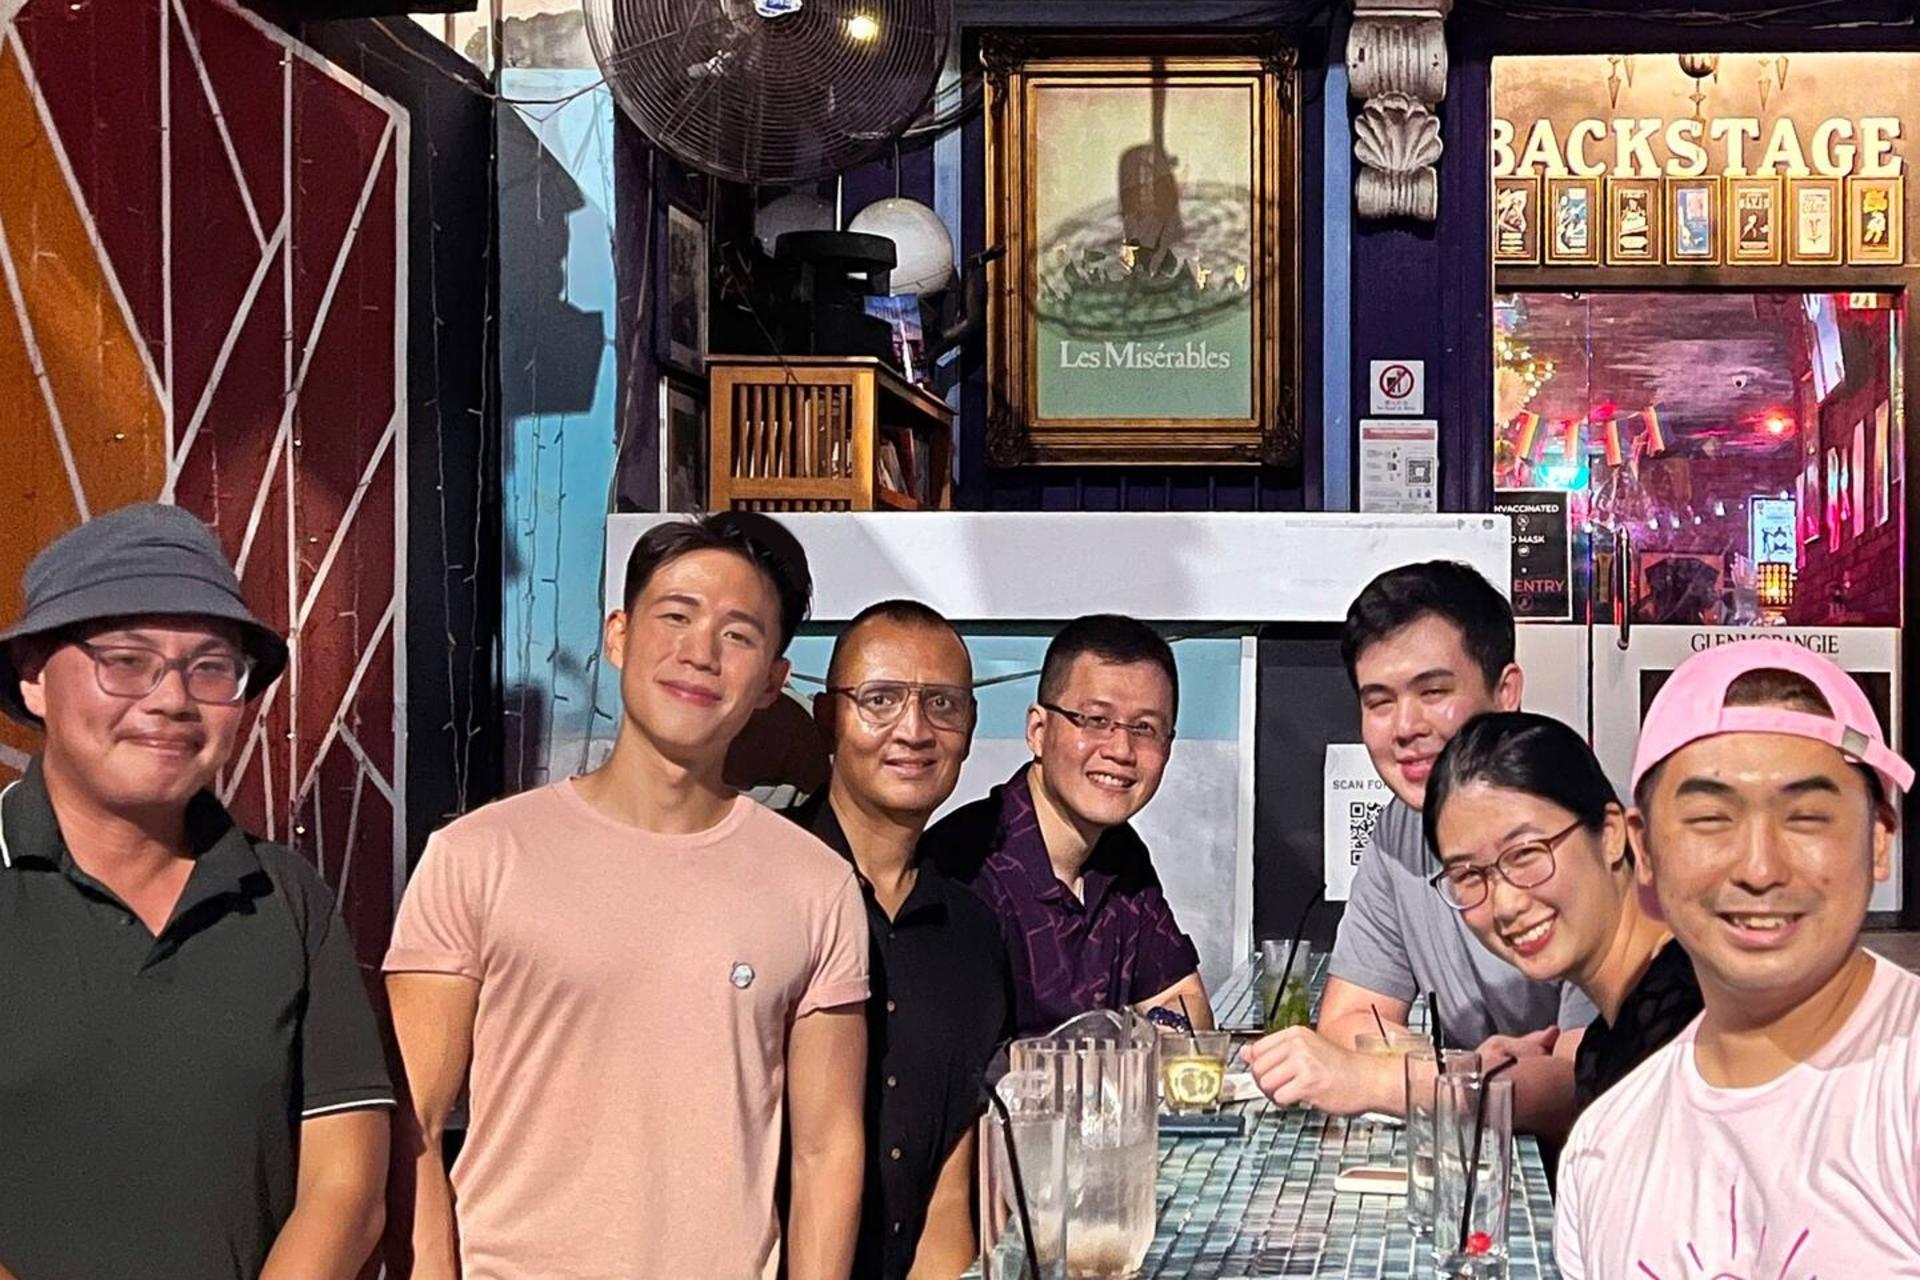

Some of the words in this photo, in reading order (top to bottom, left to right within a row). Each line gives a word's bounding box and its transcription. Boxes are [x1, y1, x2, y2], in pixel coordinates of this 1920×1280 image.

[1493, 117, 1903, 177] BACKSTAGE
[1060, 341, 1100, 369] Les
[1105, 341, 1231, 369] Misérables
[1494, 504, 1559, 513] NVACCINATED
[1519, 535, 1545, 543] MASK
[1514, 580, 1564, 592] ENTRY
[1691, 633, 1839, 654] GLENGIE
[1333, 780, 1363, 790] SCAN
